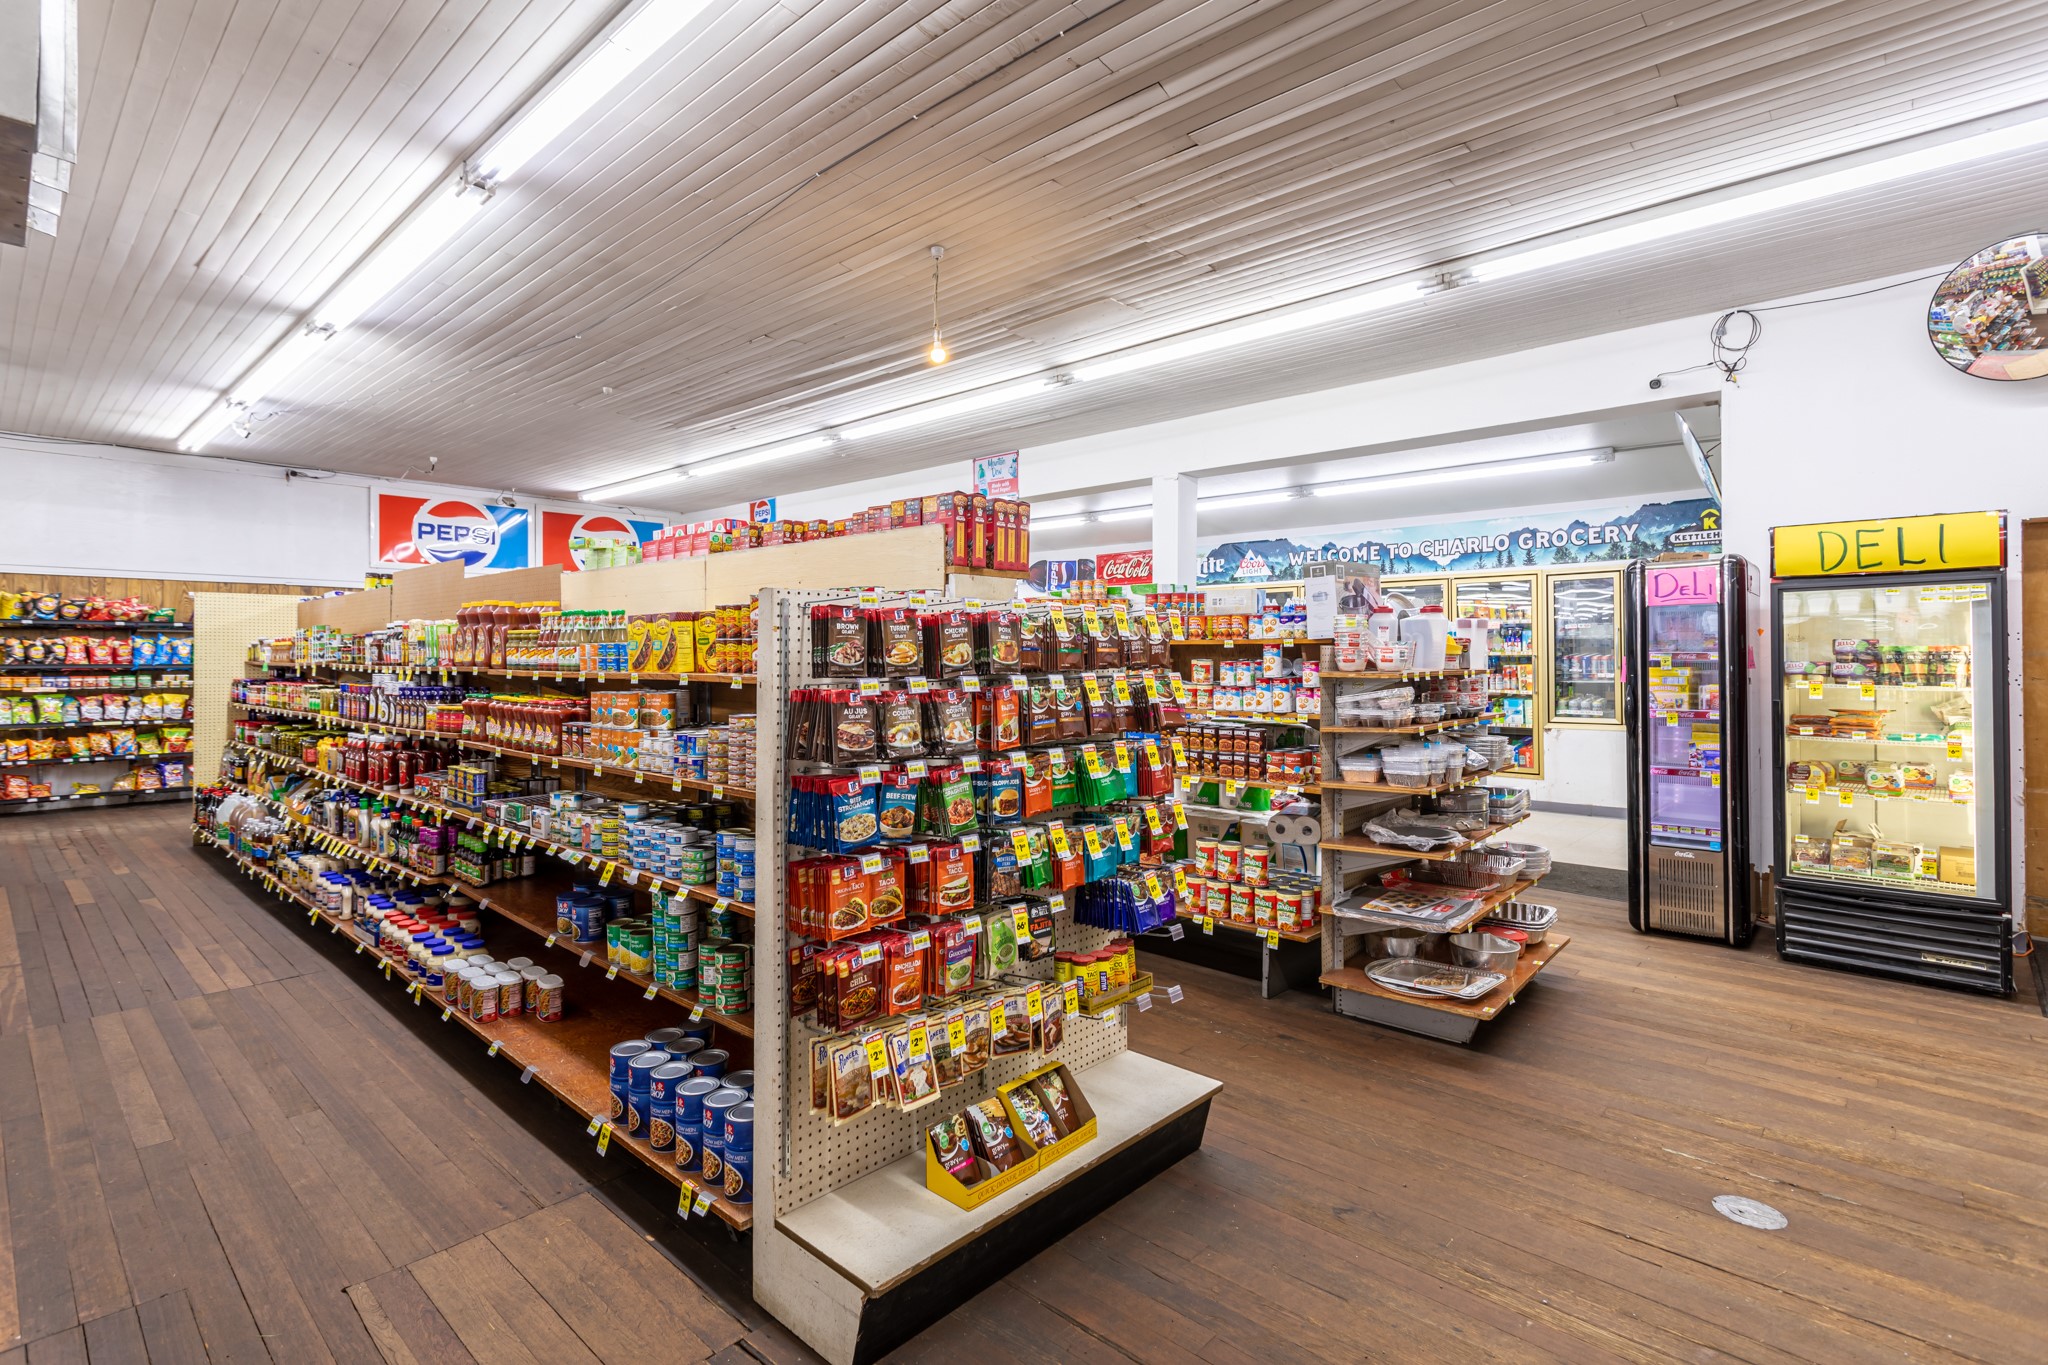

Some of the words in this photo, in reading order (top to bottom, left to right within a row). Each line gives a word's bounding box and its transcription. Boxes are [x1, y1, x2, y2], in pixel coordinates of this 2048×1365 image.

[755, 508, 770, 518] PEPSI
[1703, 516, 1718, 530] K
[417, 521, 496, 546] PEPSI
[1674, 531, 1722, 542] KETTLEH
[1288, 544, 1381, 567] WELCOME
[1386, 543, 1414, 560] TO
[1418, 532, 1510, 557] CHARLO
[1518, 523, 1640, 550] GROCERY
[1817, 523, 1950, 572] DELI
[1239, 558, 1265, 570] Coors
[1050, 561, 1059, 592] PEPSI
[1242, 568, 1263, 576] LIGHT
[945, 707, 968, 715] COUNTRY
[849, 796, 862, 804] BEEF
[885, 792, 901, 800] BEEF
[900, 793, 917, 801] STEW
[838, 798, 875, 813] STROGANOFF
[948, 867, 963, 875] TACO
[878, 878, 896, 887] TACO
[1029, 919, 1053, 931] FAJITA
[894, 960, 921, 971] ENCHILADA
[849, 975, 868, 988] CHILI
